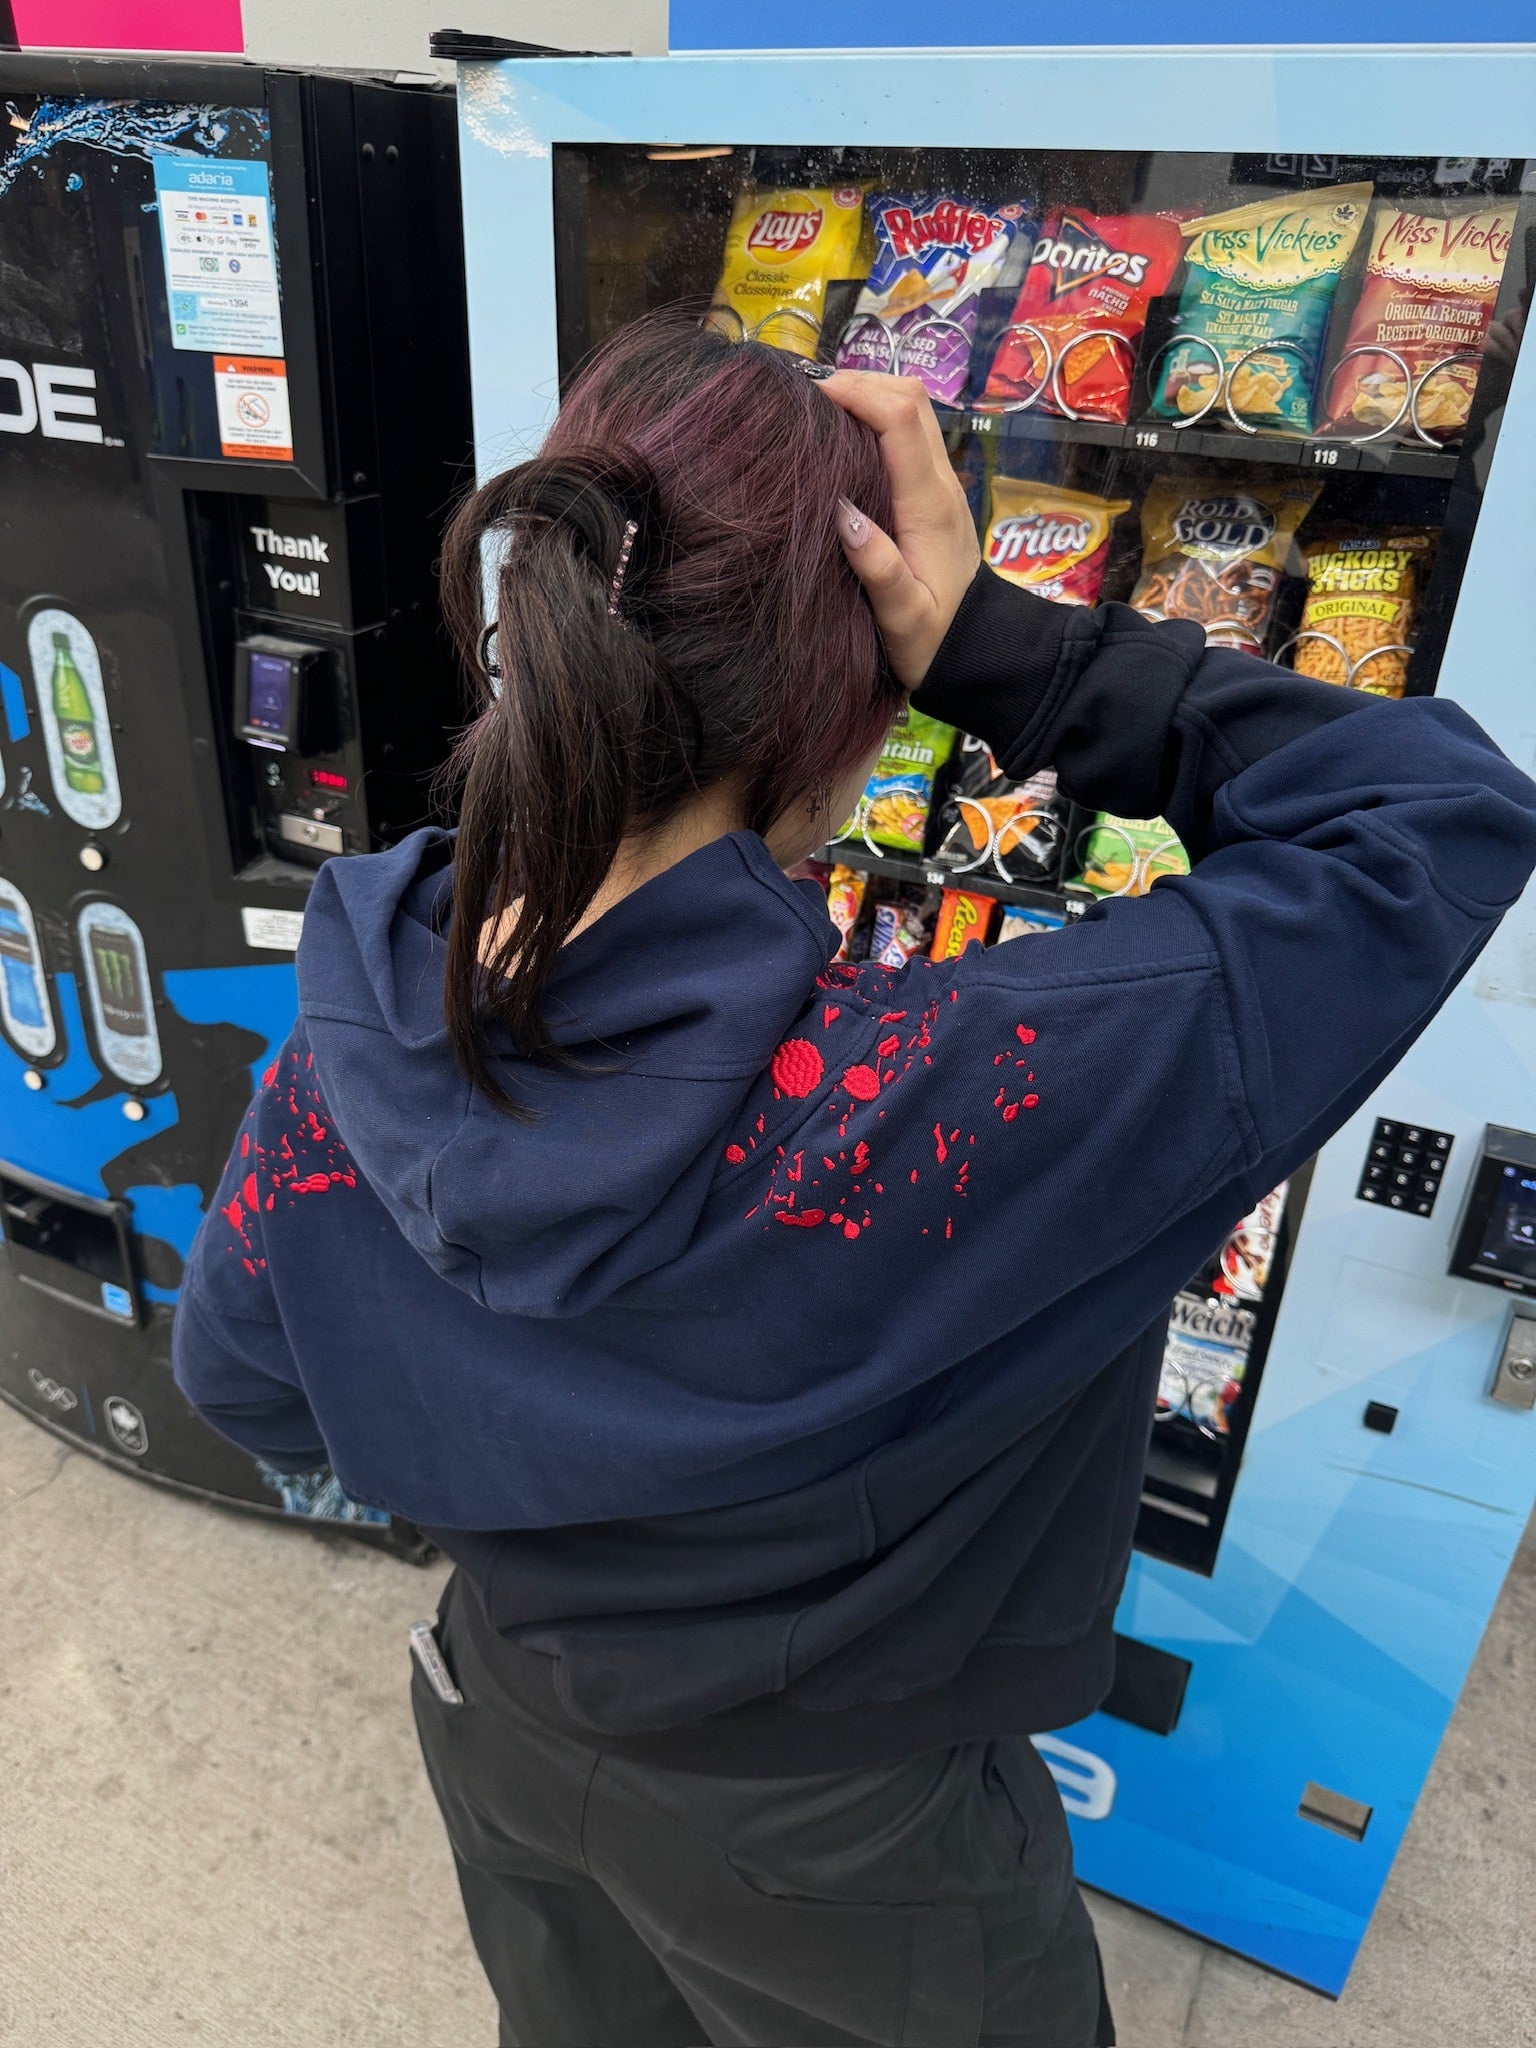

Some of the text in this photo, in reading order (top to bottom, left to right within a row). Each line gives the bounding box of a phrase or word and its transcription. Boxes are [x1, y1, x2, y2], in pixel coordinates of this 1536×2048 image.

[188, 171, 233, 186] adaria
[750, 210, 820, 252] Lay's
[882, 199, 1005, 260] Ruffles
[1256, 212, 1342, 263] Vickie's
[1031, 237, 1150, 284] Doritos
[745, 270, 790, 284] Classic
[733, 283, 794, 300] Classique
[1384, 302, 1484, 327] ORIGINAL RECIPE
[1376, 323, 1485, 346] RECETTE ORIGINALE
[971, 418, 992, 432] 114
[1135, 432, 1159, 447] 116
[1313, 450, 1339, 465] 118
[1178, 500, 1254, 519] ROLD
[249, 526, 330, 563] Thank
[989, 513, 1092, 566] Fritos
[1173, 516, 1270, 548] GOLD
[1307, 551, 1413, 579] HICKORY
[263, 563, 321, 597] You!
[1310, 567, 1401, 594] STICKS
[1315, 600, 1388, 617] ORIGINAL
[1382, 1124, 1448, 1149] 1 2 3
